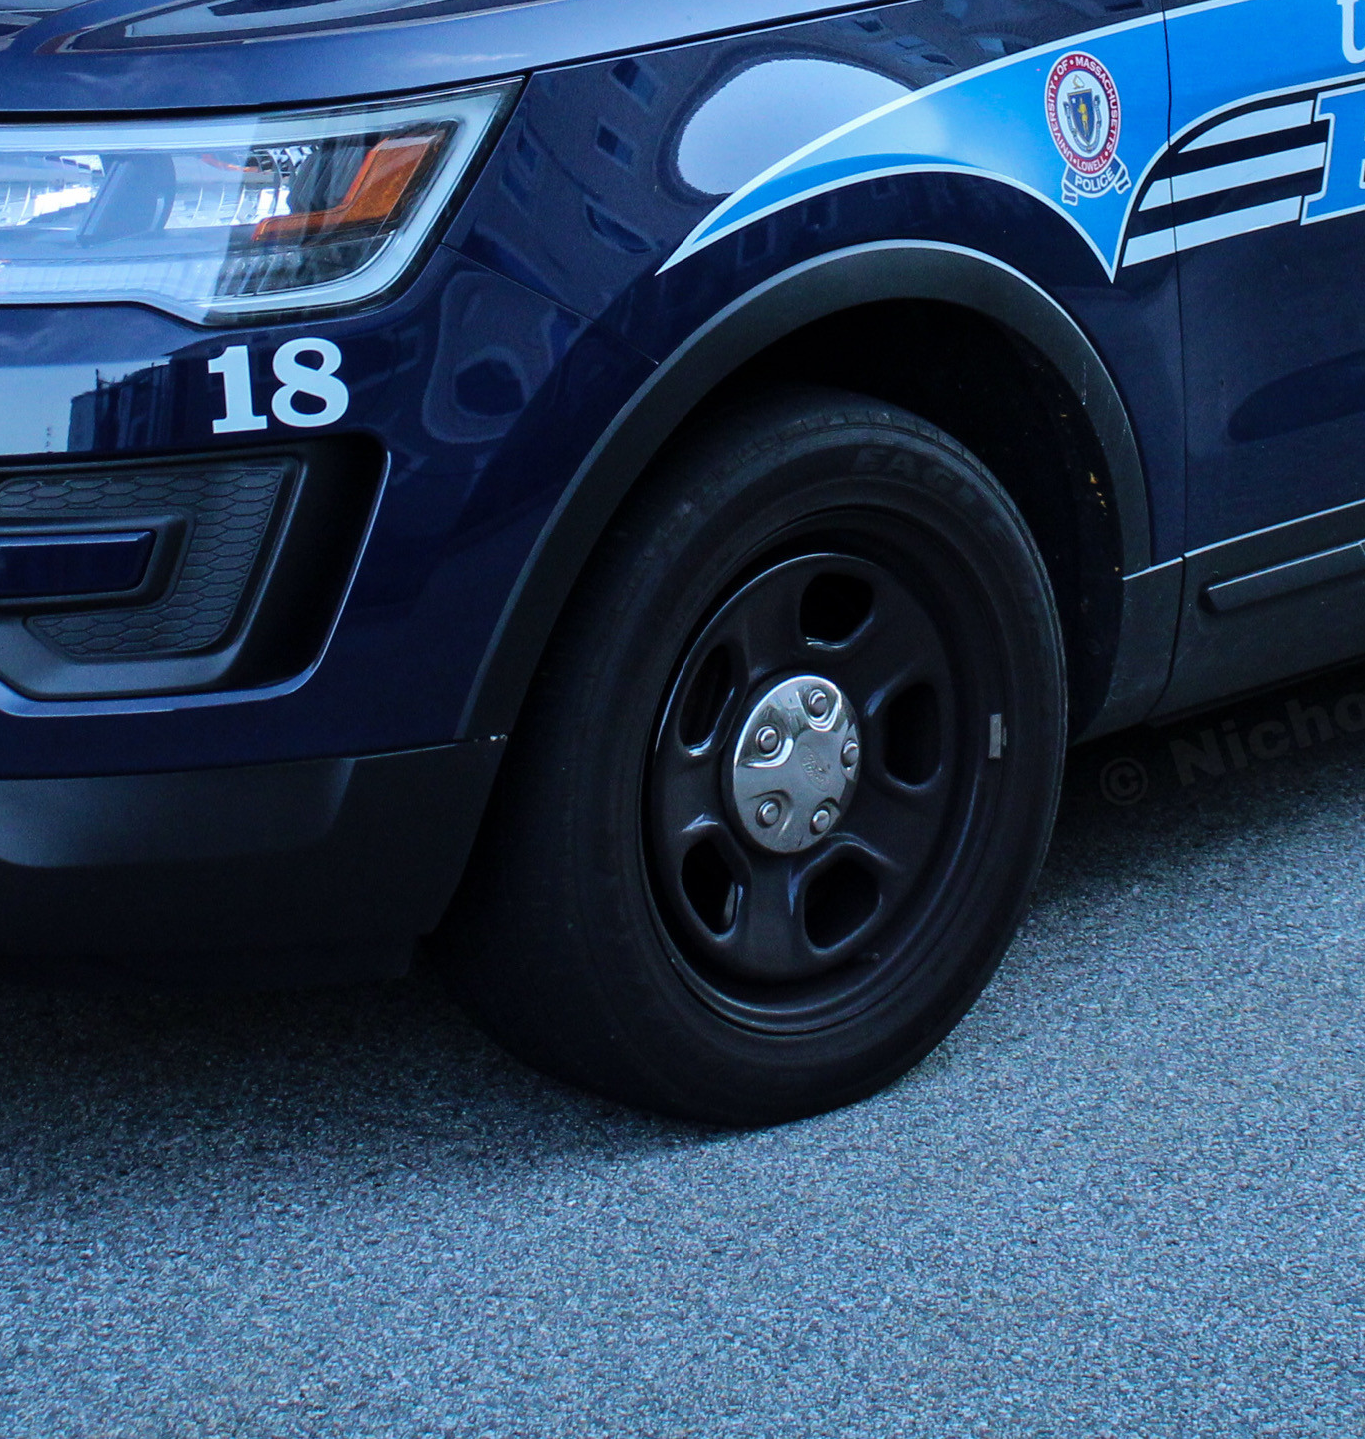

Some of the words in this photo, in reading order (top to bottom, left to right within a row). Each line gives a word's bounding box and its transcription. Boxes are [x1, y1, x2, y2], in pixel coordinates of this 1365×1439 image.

[1056, 59, 1070, 76] OF
[1047, 81, 1074, 164] UNIVERSITY
[1075, 55, 1119, 153] MASSACHUSETTS
[1075, 166, 1115, 192] POLICE
[1076, 156, 1108, 172] LOWELL
[207, 337, 349, 434] 18
